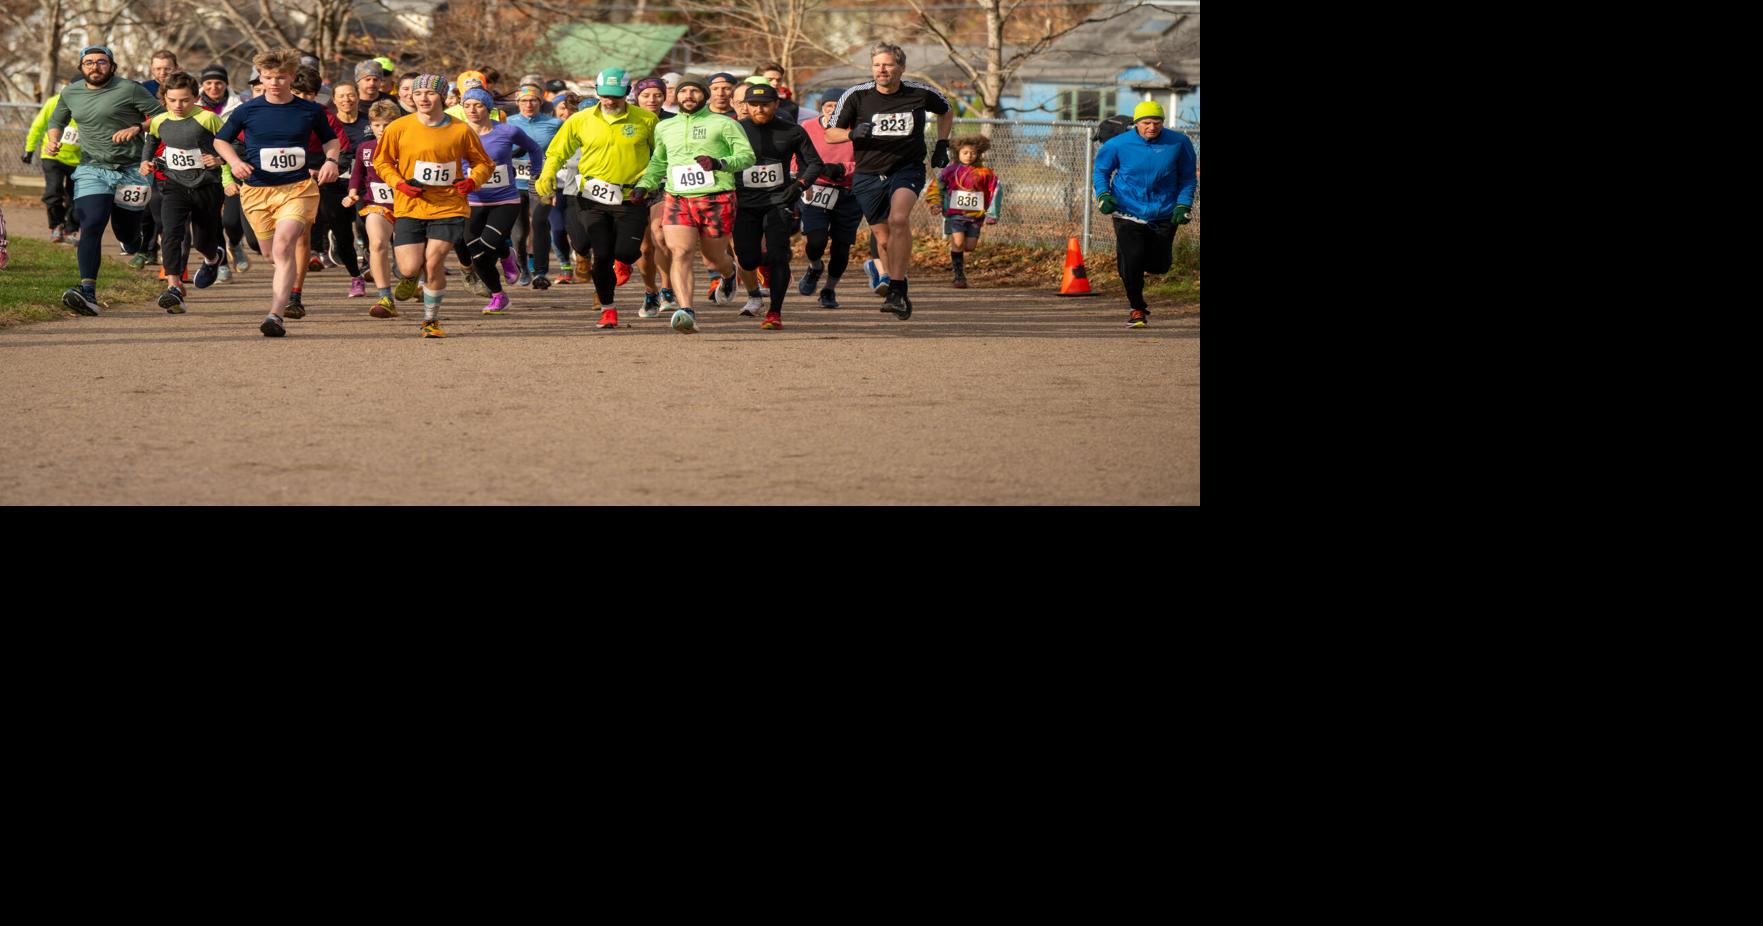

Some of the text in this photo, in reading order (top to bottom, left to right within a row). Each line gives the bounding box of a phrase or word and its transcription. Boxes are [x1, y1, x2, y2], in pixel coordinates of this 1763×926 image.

[692, 128, 707, 136] CHI
[880, 119, 906, 132] 823
[64, 131, 78, 143] 81
[172, 154, 195, 167] 835
[270, 155, 297, 169] 490
[422, 168, 449, 182] 815
[518, 165, 531, 176] 83
[751, 170, 776, 183] 826
[680, 172, 705, 186] 499
[123, 189, 147, 203] 831
[379, 188, 394, 200] 81
[592, 184, 615, 202] 821
[957, 195, 978, 207] 836
